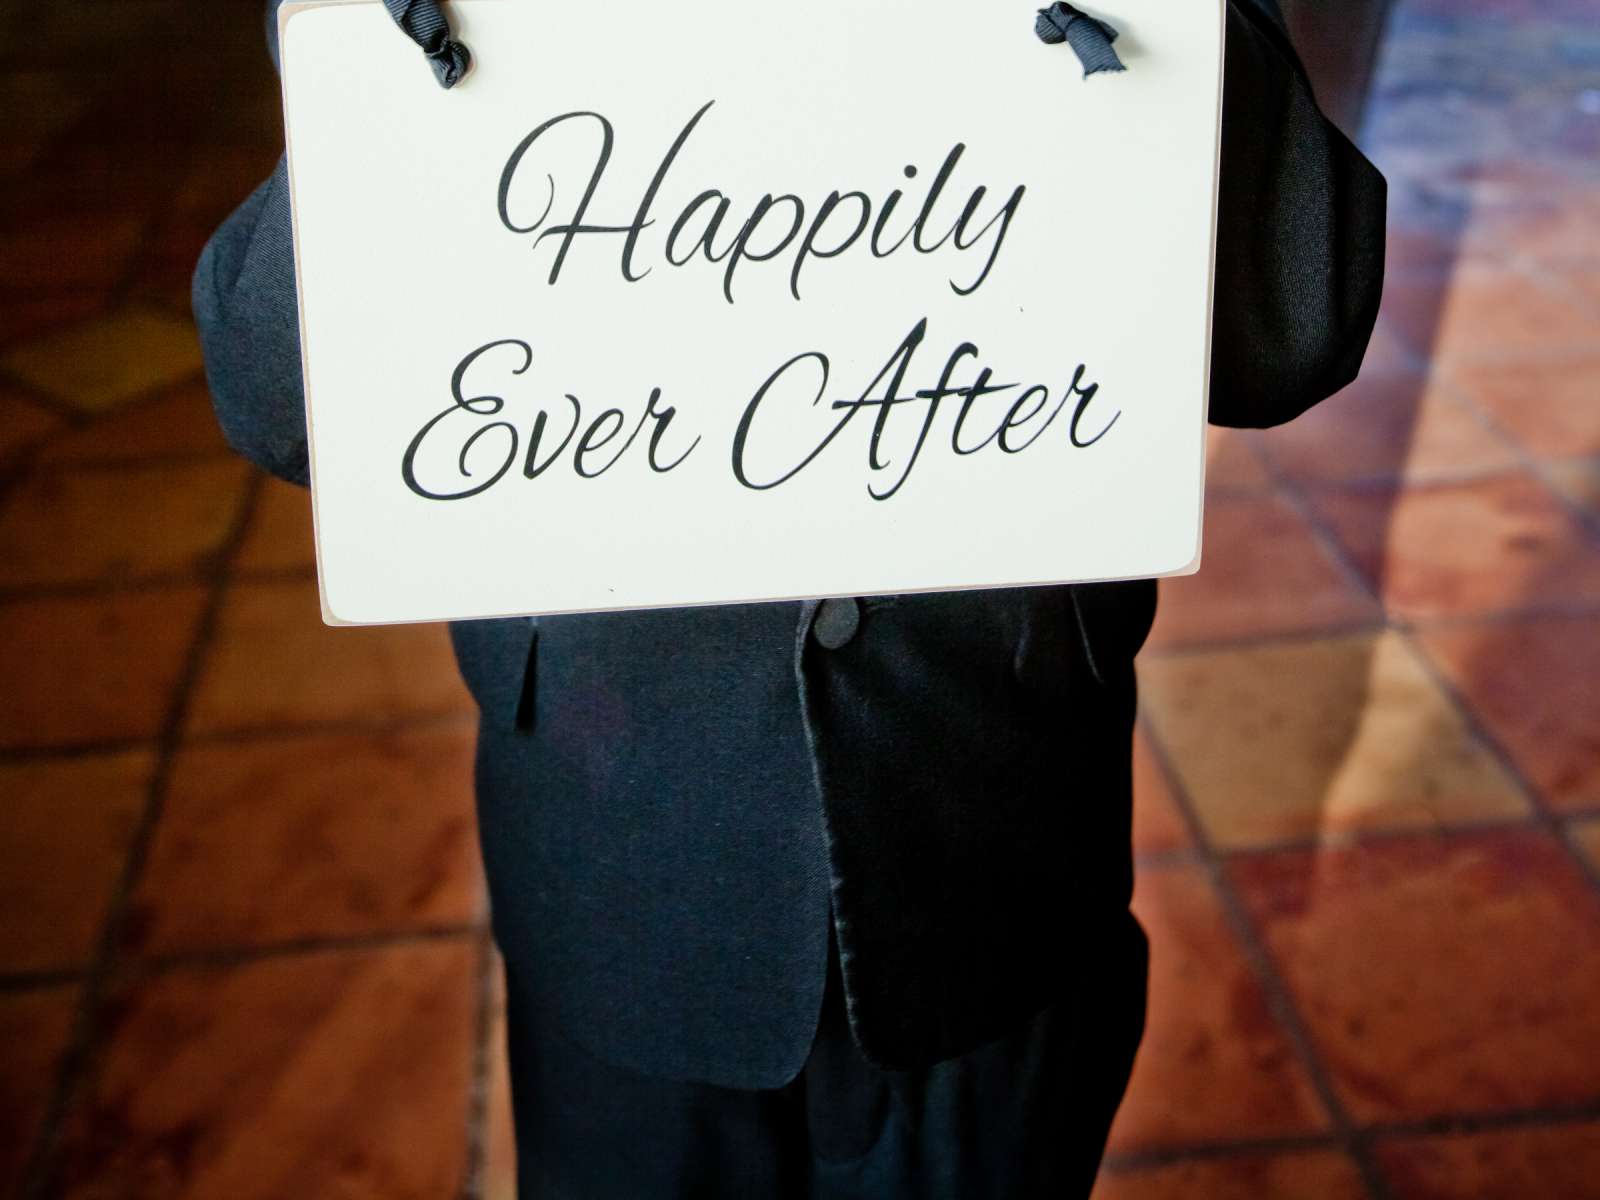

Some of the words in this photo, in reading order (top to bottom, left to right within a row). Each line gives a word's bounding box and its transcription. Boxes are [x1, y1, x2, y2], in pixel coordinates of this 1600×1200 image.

[497, 99, 1026, 305] Happily
[401, 339, 702, 501] Ever
[731, 316, 1121, 502] After
